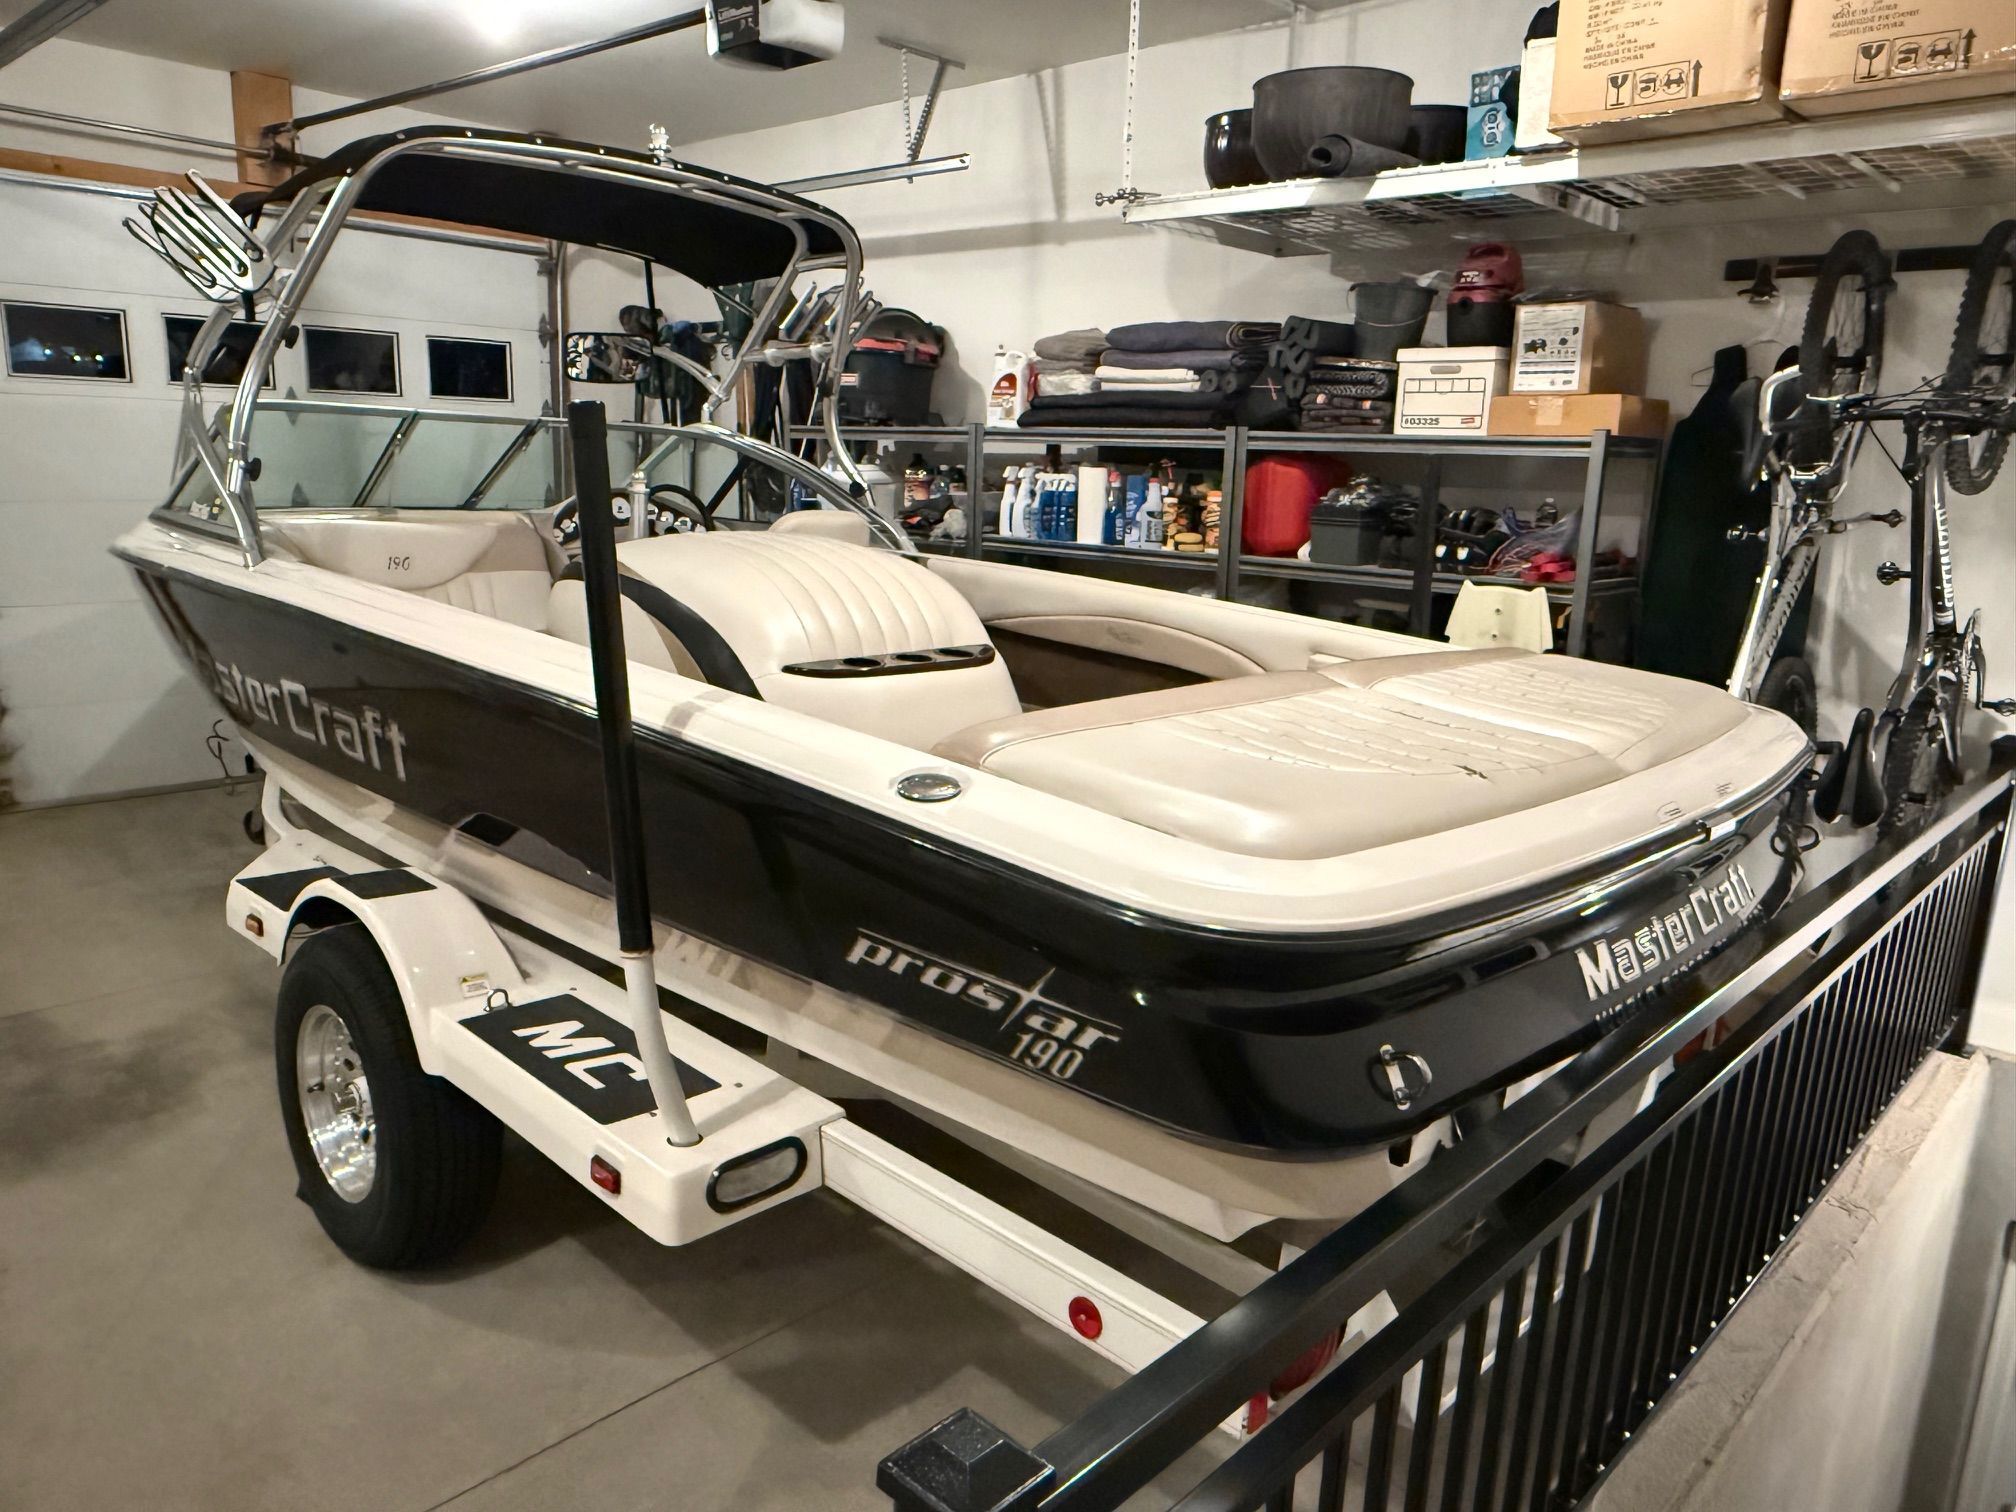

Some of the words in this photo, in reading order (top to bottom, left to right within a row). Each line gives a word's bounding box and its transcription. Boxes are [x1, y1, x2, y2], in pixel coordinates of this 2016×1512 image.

[1574, 863, 1755, 1002] MasterCraft
[511, 1020, 650, 1090] MC
[1009, 1032, 1084, 1080] 190
